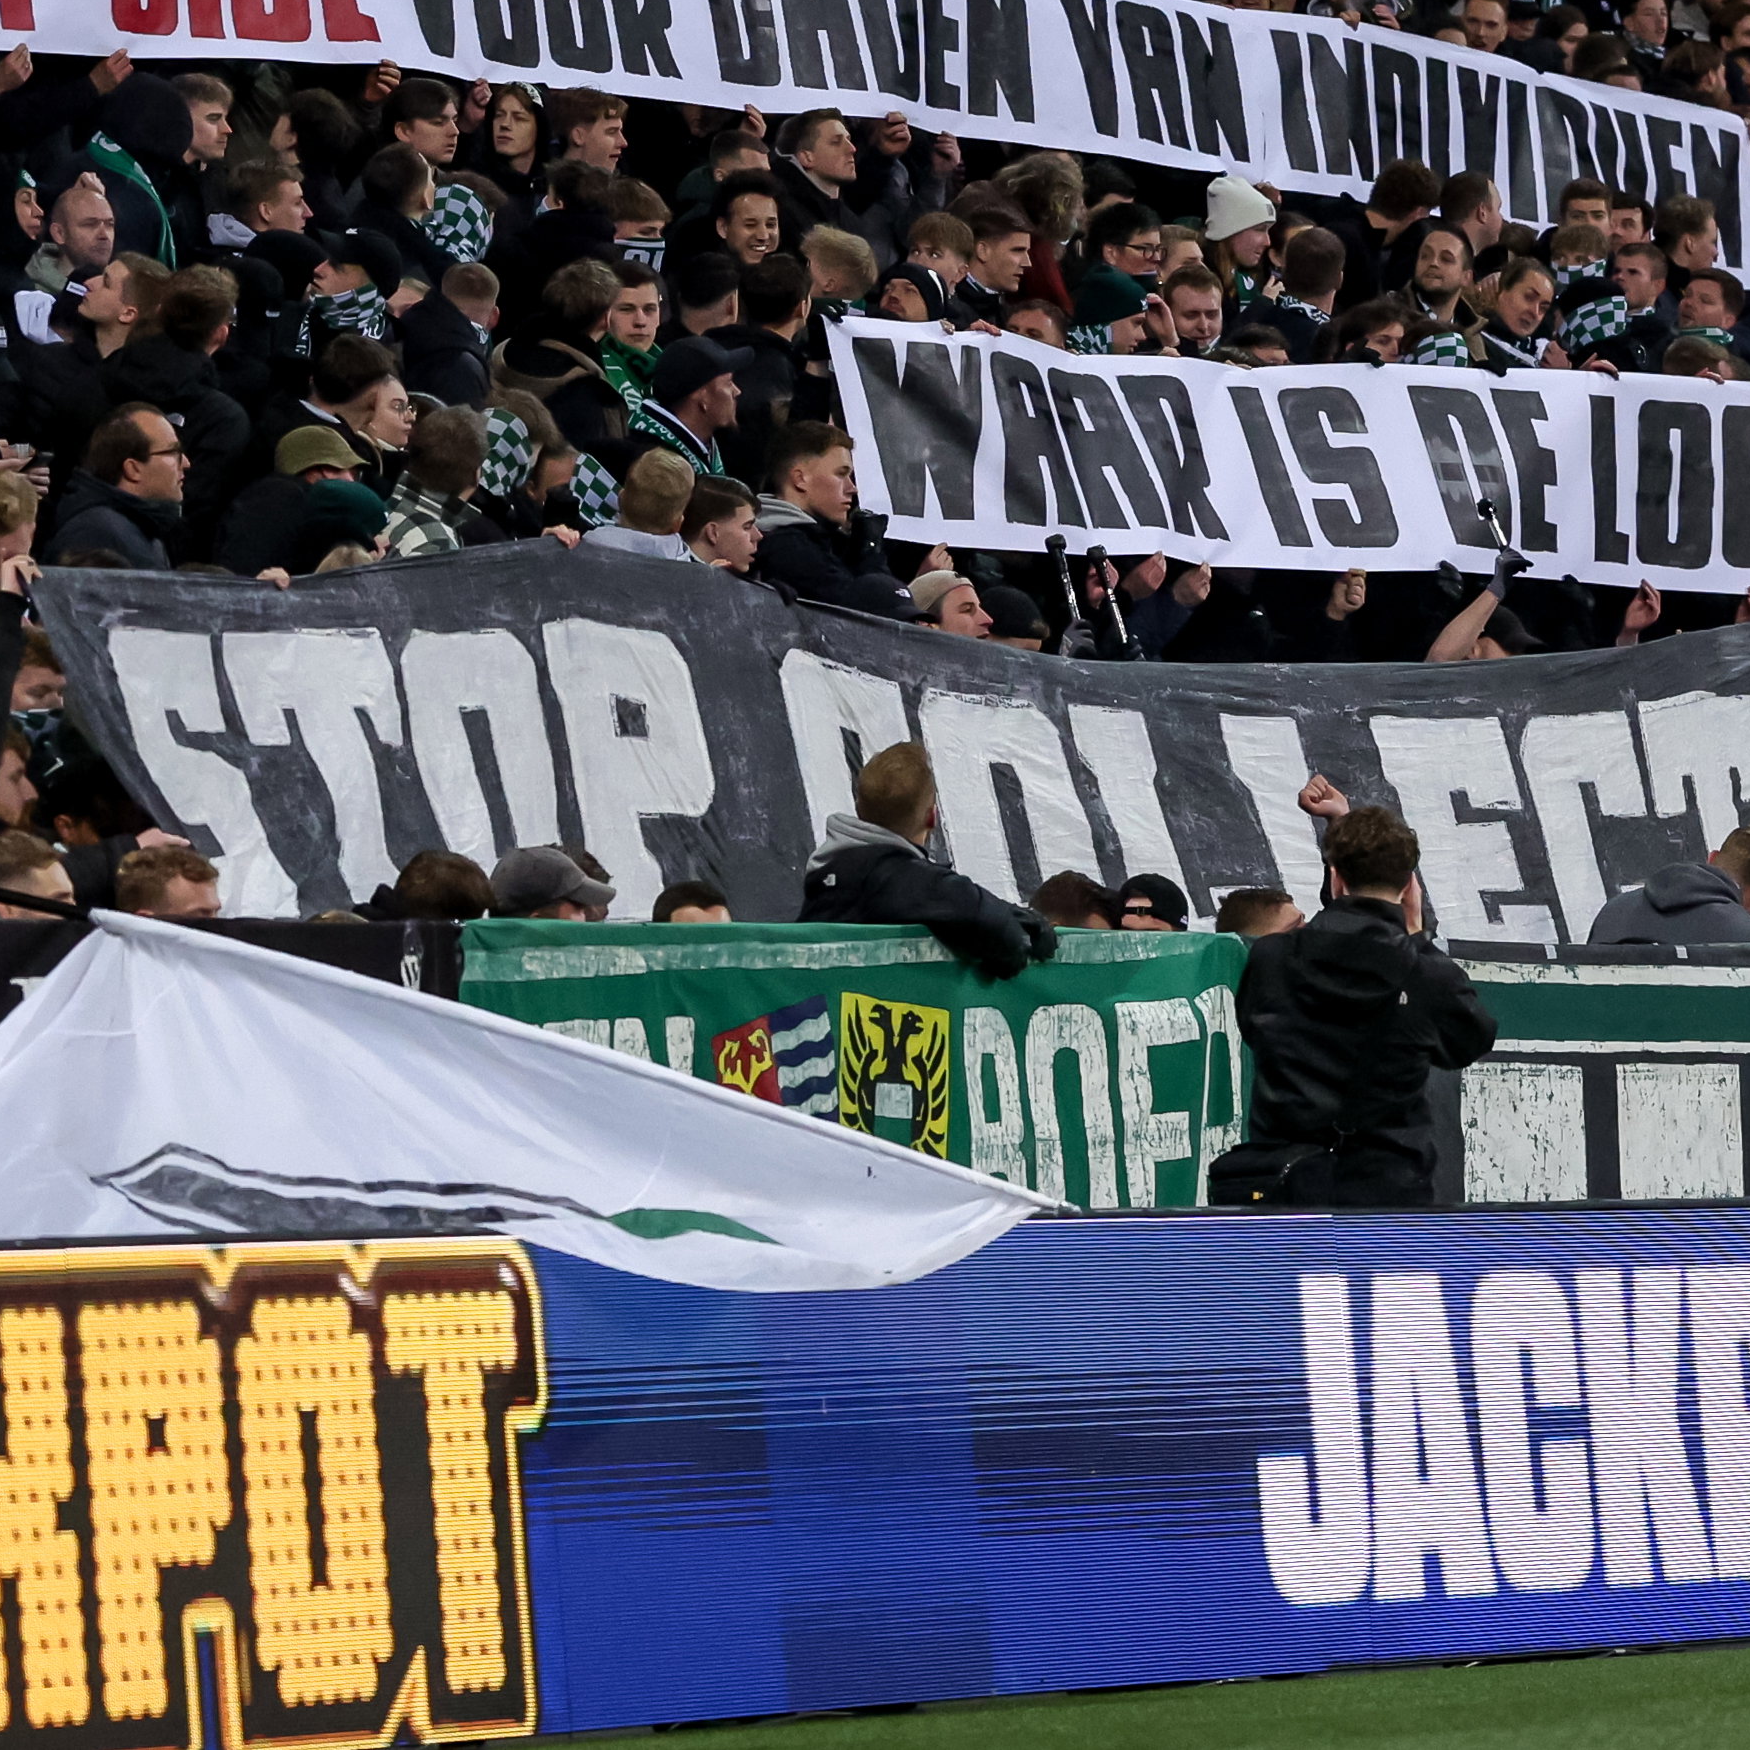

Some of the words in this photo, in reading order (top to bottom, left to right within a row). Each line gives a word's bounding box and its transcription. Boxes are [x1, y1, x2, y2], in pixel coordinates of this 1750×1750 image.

[851, 336, 1231, 542] WAAR
[1226, 385, 1399, 548] IS
[1406, 385, 1559, 554] DE
[107, 617, 715, 924] STOP
